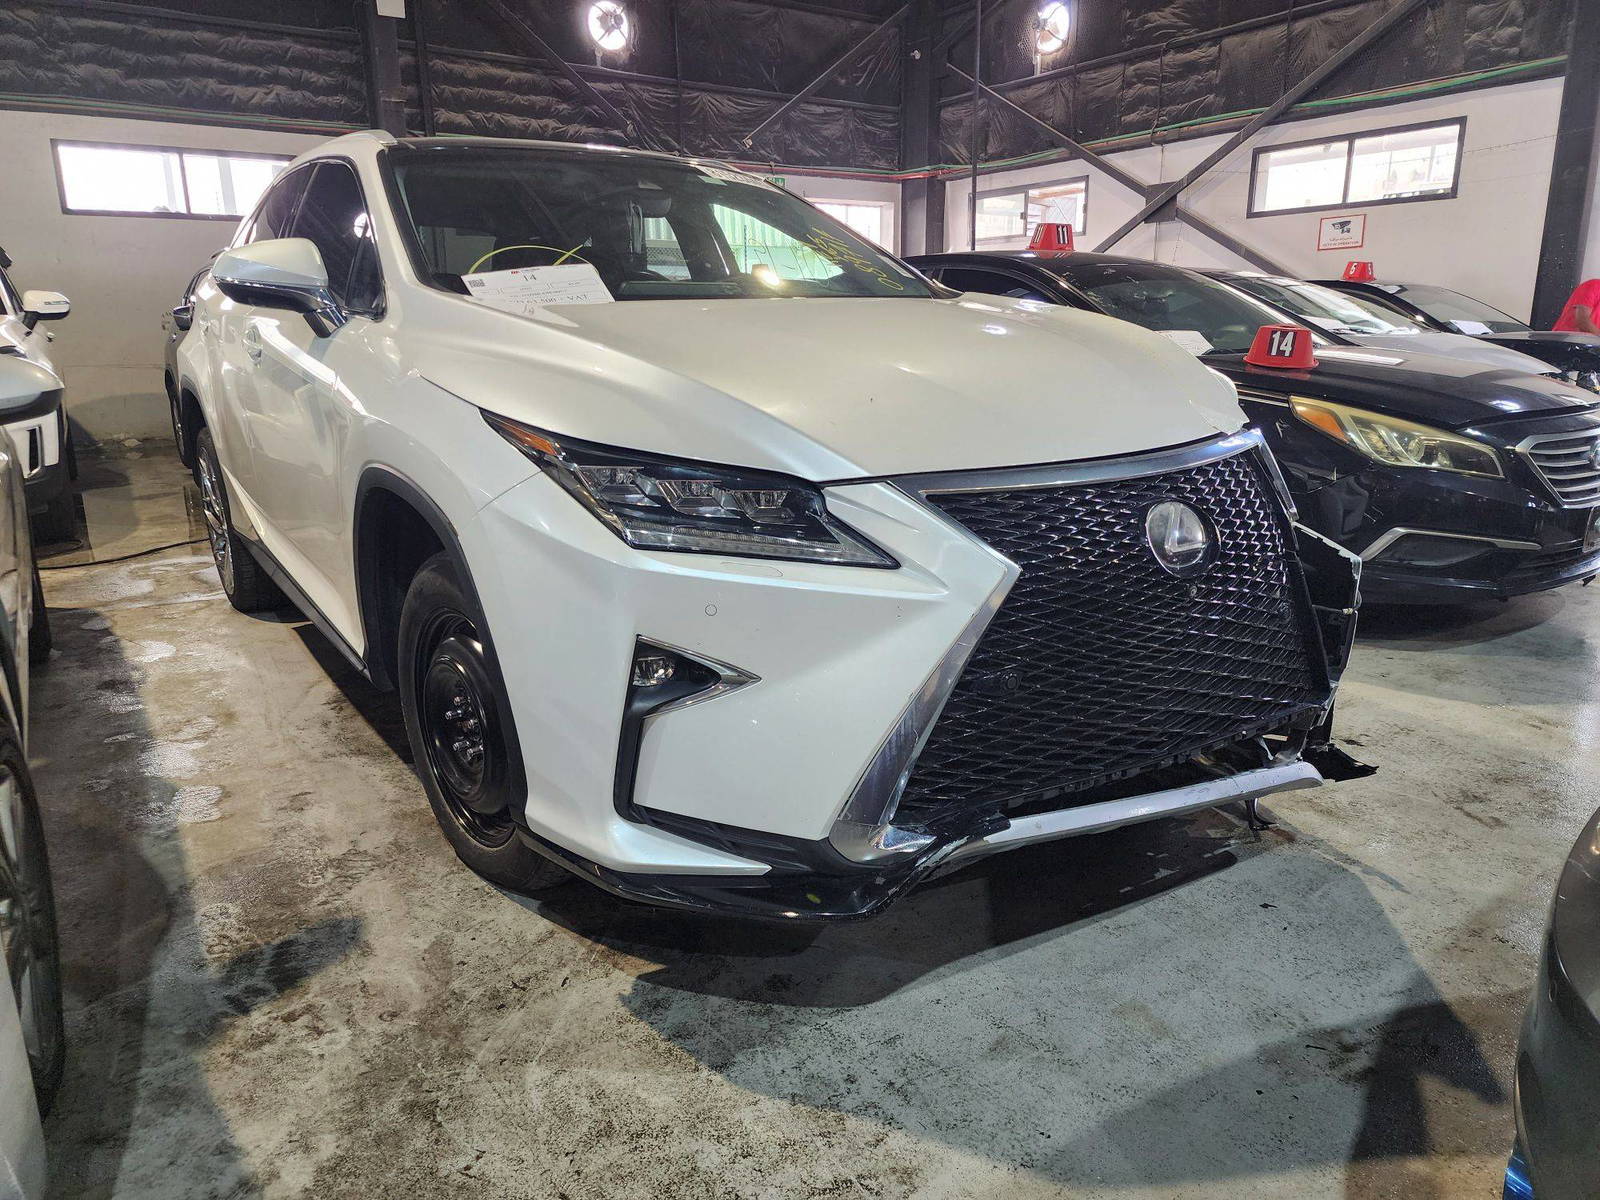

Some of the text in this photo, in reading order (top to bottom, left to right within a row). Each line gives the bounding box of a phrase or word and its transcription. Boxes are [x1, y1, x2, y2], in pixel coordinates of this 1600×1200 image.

[1057, 225, 1069, 245] 11
[523, 274, 537, 282] 14
[1270, 330, 1295, 357] 14
